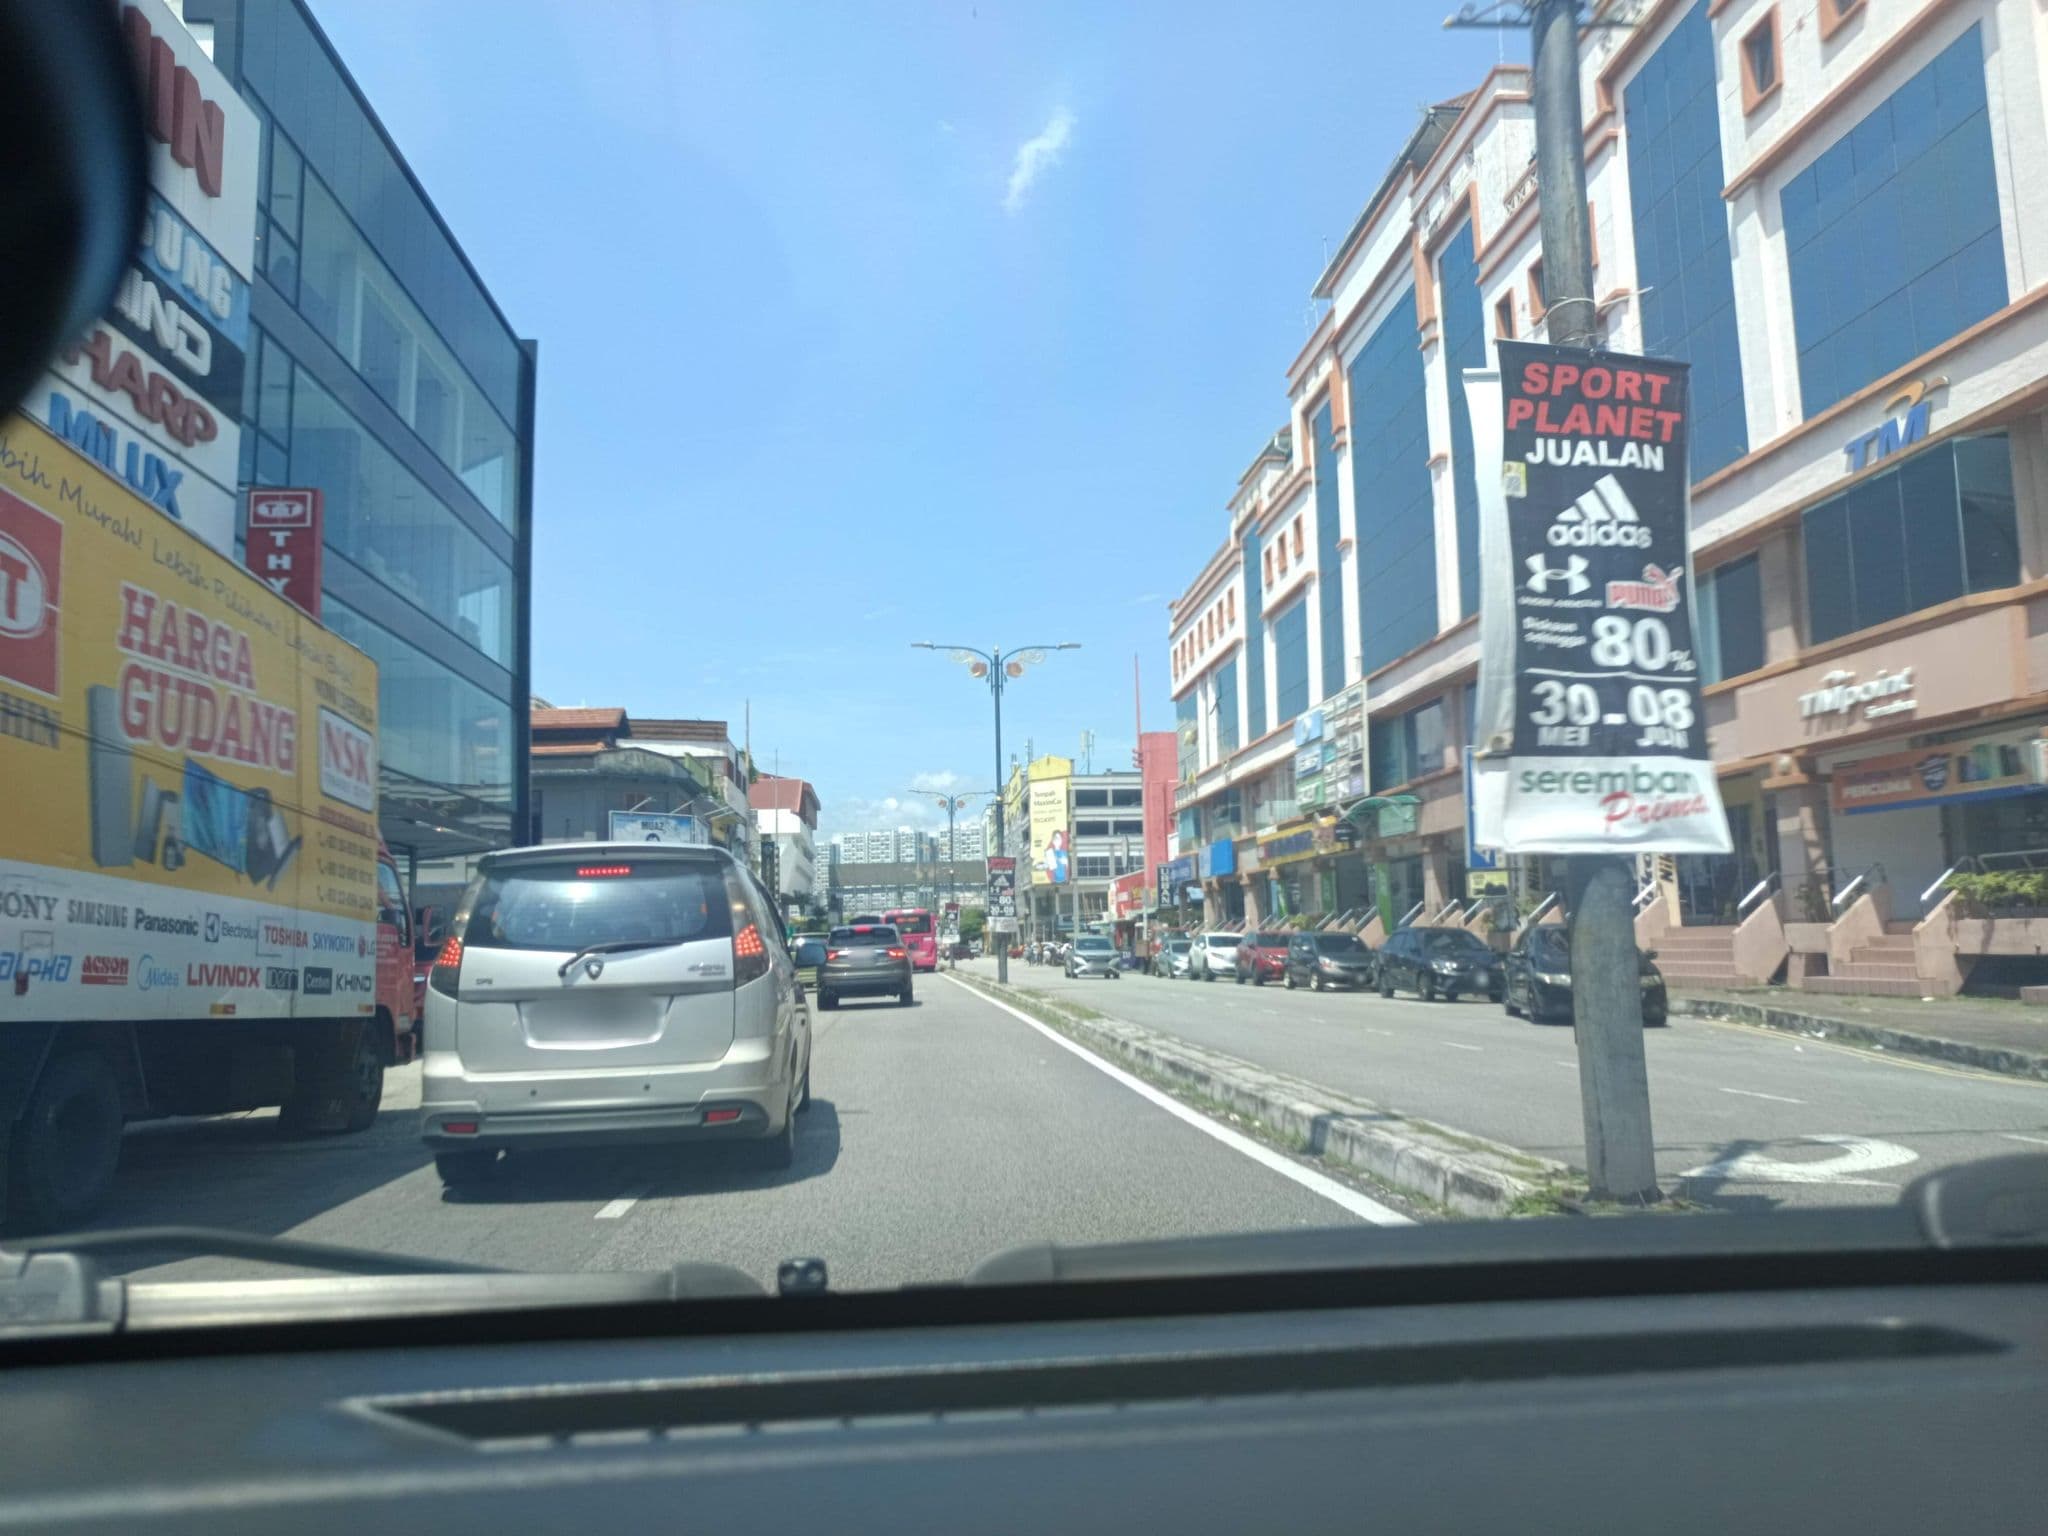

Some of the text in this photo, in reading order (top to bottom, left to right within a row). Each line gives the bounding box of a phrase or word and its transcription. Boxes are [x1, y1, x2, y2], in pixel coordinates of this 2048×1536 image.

[1521, 362, 1671, 404] SPORT
[1507, 398, 1682, 443] PLANET
[1843, 400, 1931, 473] TM
[50, 391, 184, 521] MILUX
[1525, 438, 1664, 472] JUALAN
[1546, 519, 1653, 549] adidas
[117, 581, 258, 692] HARGA
[119, 662, 297, 776] GUDANG
[1537, 726, 1591, 747] MEI
[324, 713, 371, 786] NSK
[67, 898, 129, 929] SAMSUNG
[134, 906, 200, 937] Panasonic
[264, 924, 309, 949] TOSHIBA
[312, 932, 355, 953] SKYWORTH
[187, 962, 261, 989] LIVINOX
[335, 973, 372, 993] KHIND
